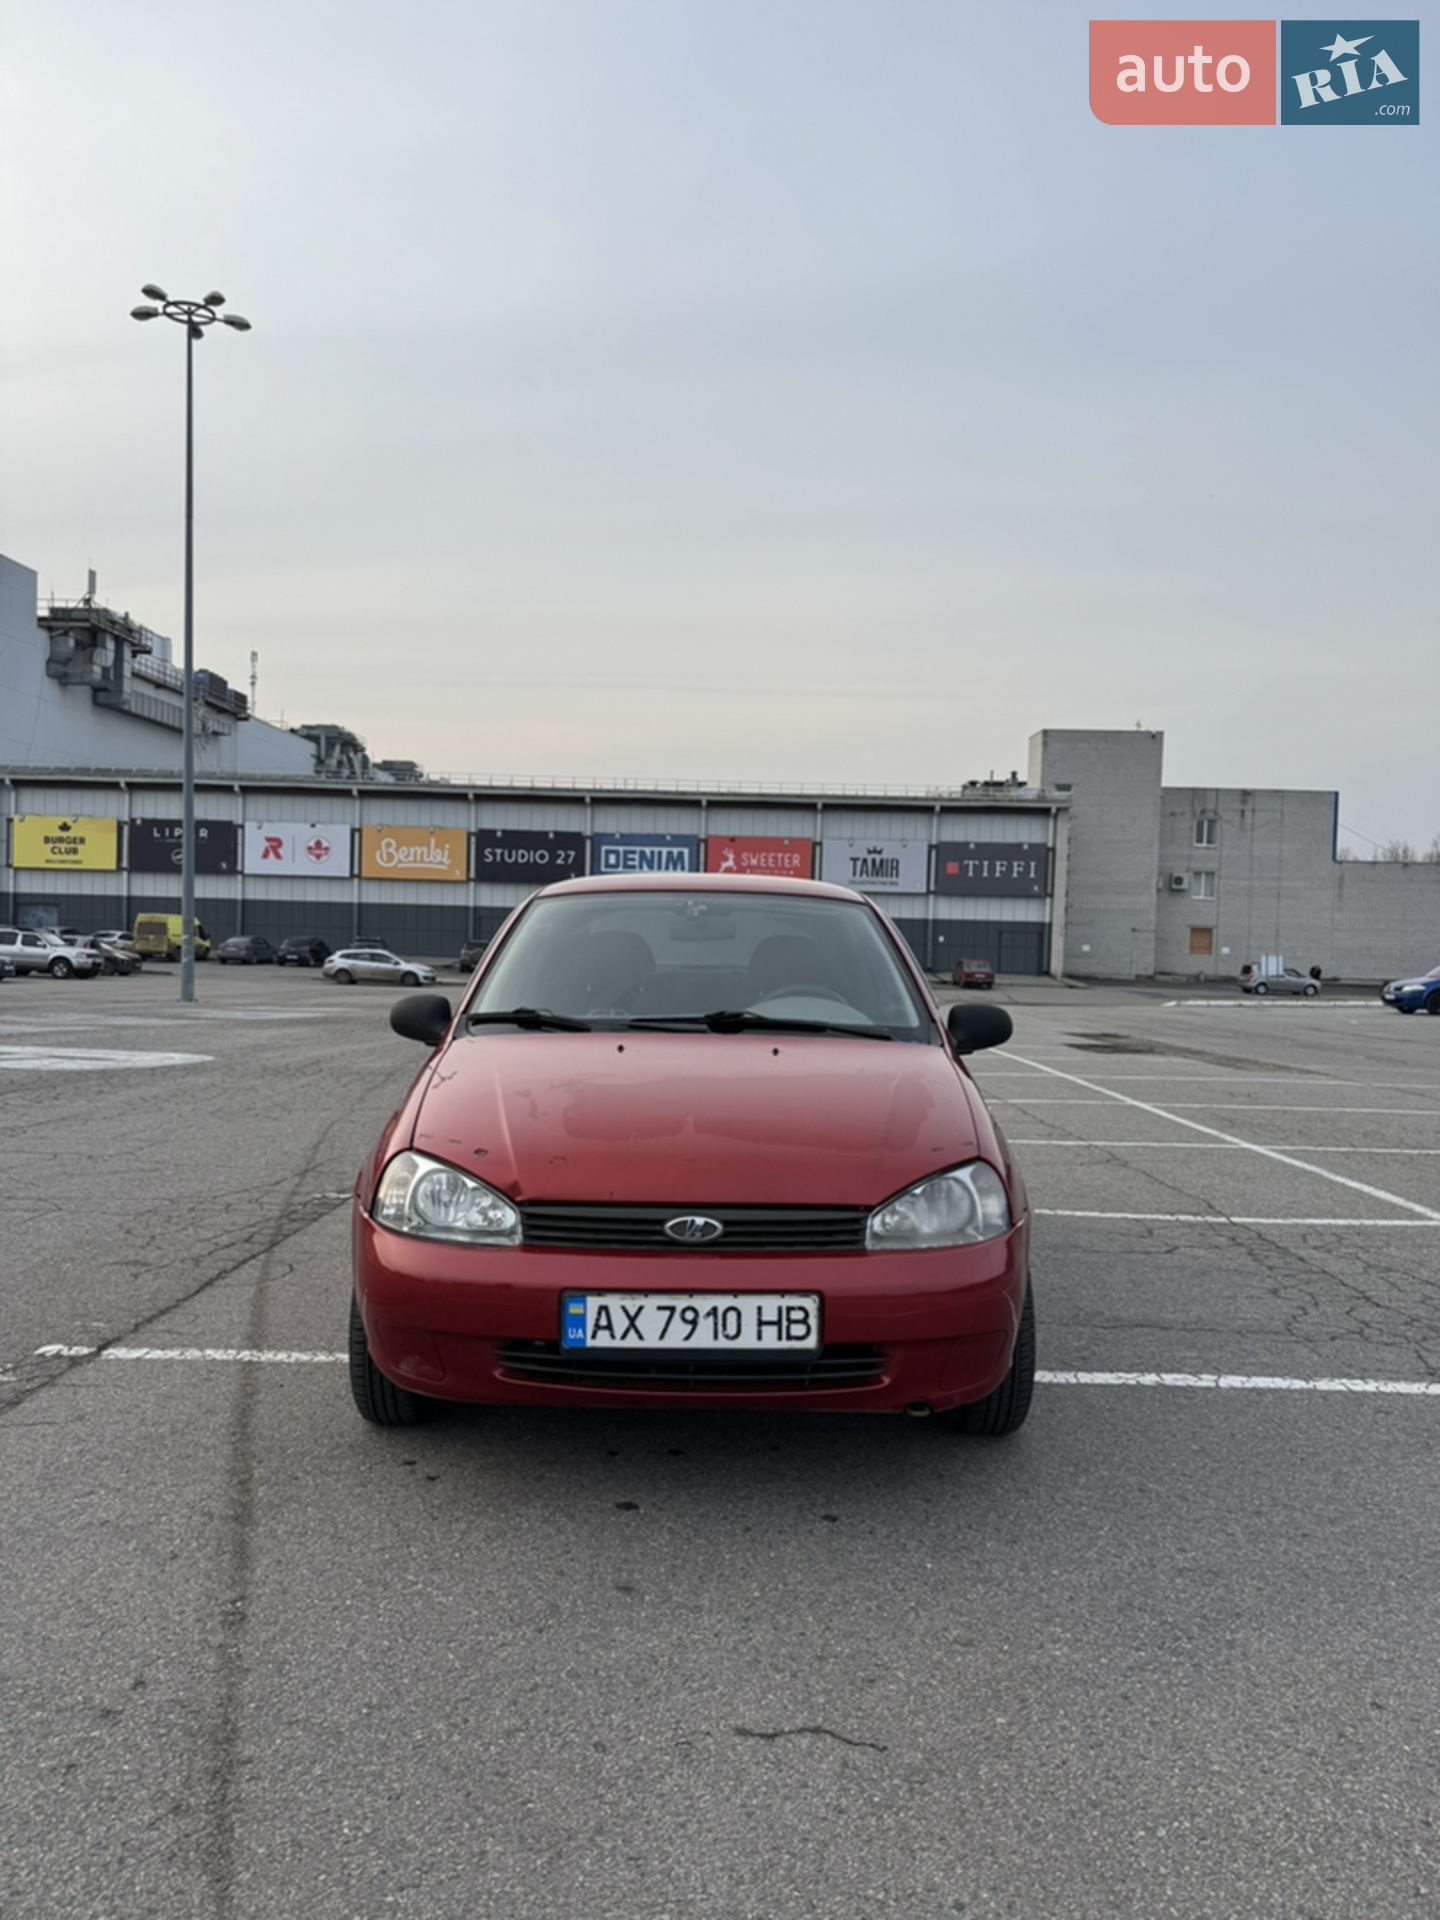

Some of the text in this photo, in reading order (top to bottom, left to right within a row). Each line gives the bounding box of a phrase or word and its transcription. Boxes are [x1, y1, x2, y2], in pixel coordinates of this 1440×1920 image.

[43, 835, 86, 845] BURGER
[153, 827, 209, 839] LIPR
[50, 846, 79, 855] CLUB
[375, 837, 452, 868] Bembi
[483, 847, 576, 865] STUDIO 27
[741, 851, 801, 868] SWEETER
[602, 848, 688, 872] DENIM
[848, 856, 900, 879] TAMIR
[963, 860, 1037, 878] TIFFI
[590, 1304, 812, 1341] AX 7910 HB
[568, 1328, 585, 1339] UA
